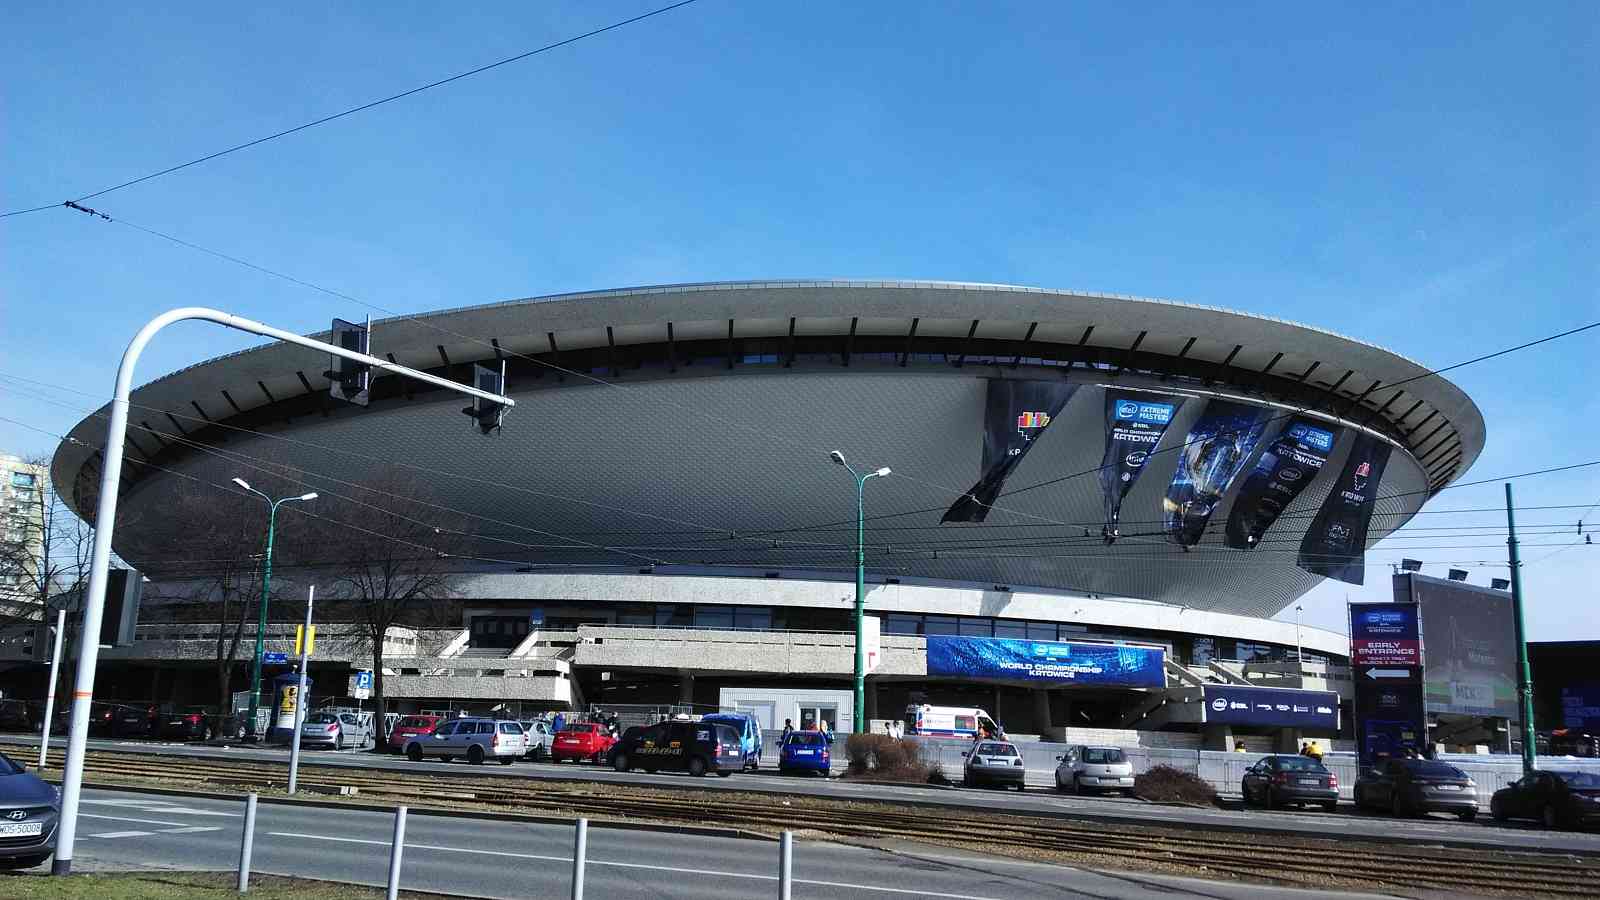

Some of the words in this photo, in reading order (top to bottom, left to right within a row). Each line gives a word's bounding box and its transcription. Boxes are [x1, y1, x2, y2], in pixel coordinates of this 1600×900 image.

[1000, 662, 1033, 670] WORLD
[1034, 663, 1103, 674] CHAMPIONSHIP
[1028, 669, 1075, 678] KATOWICE
